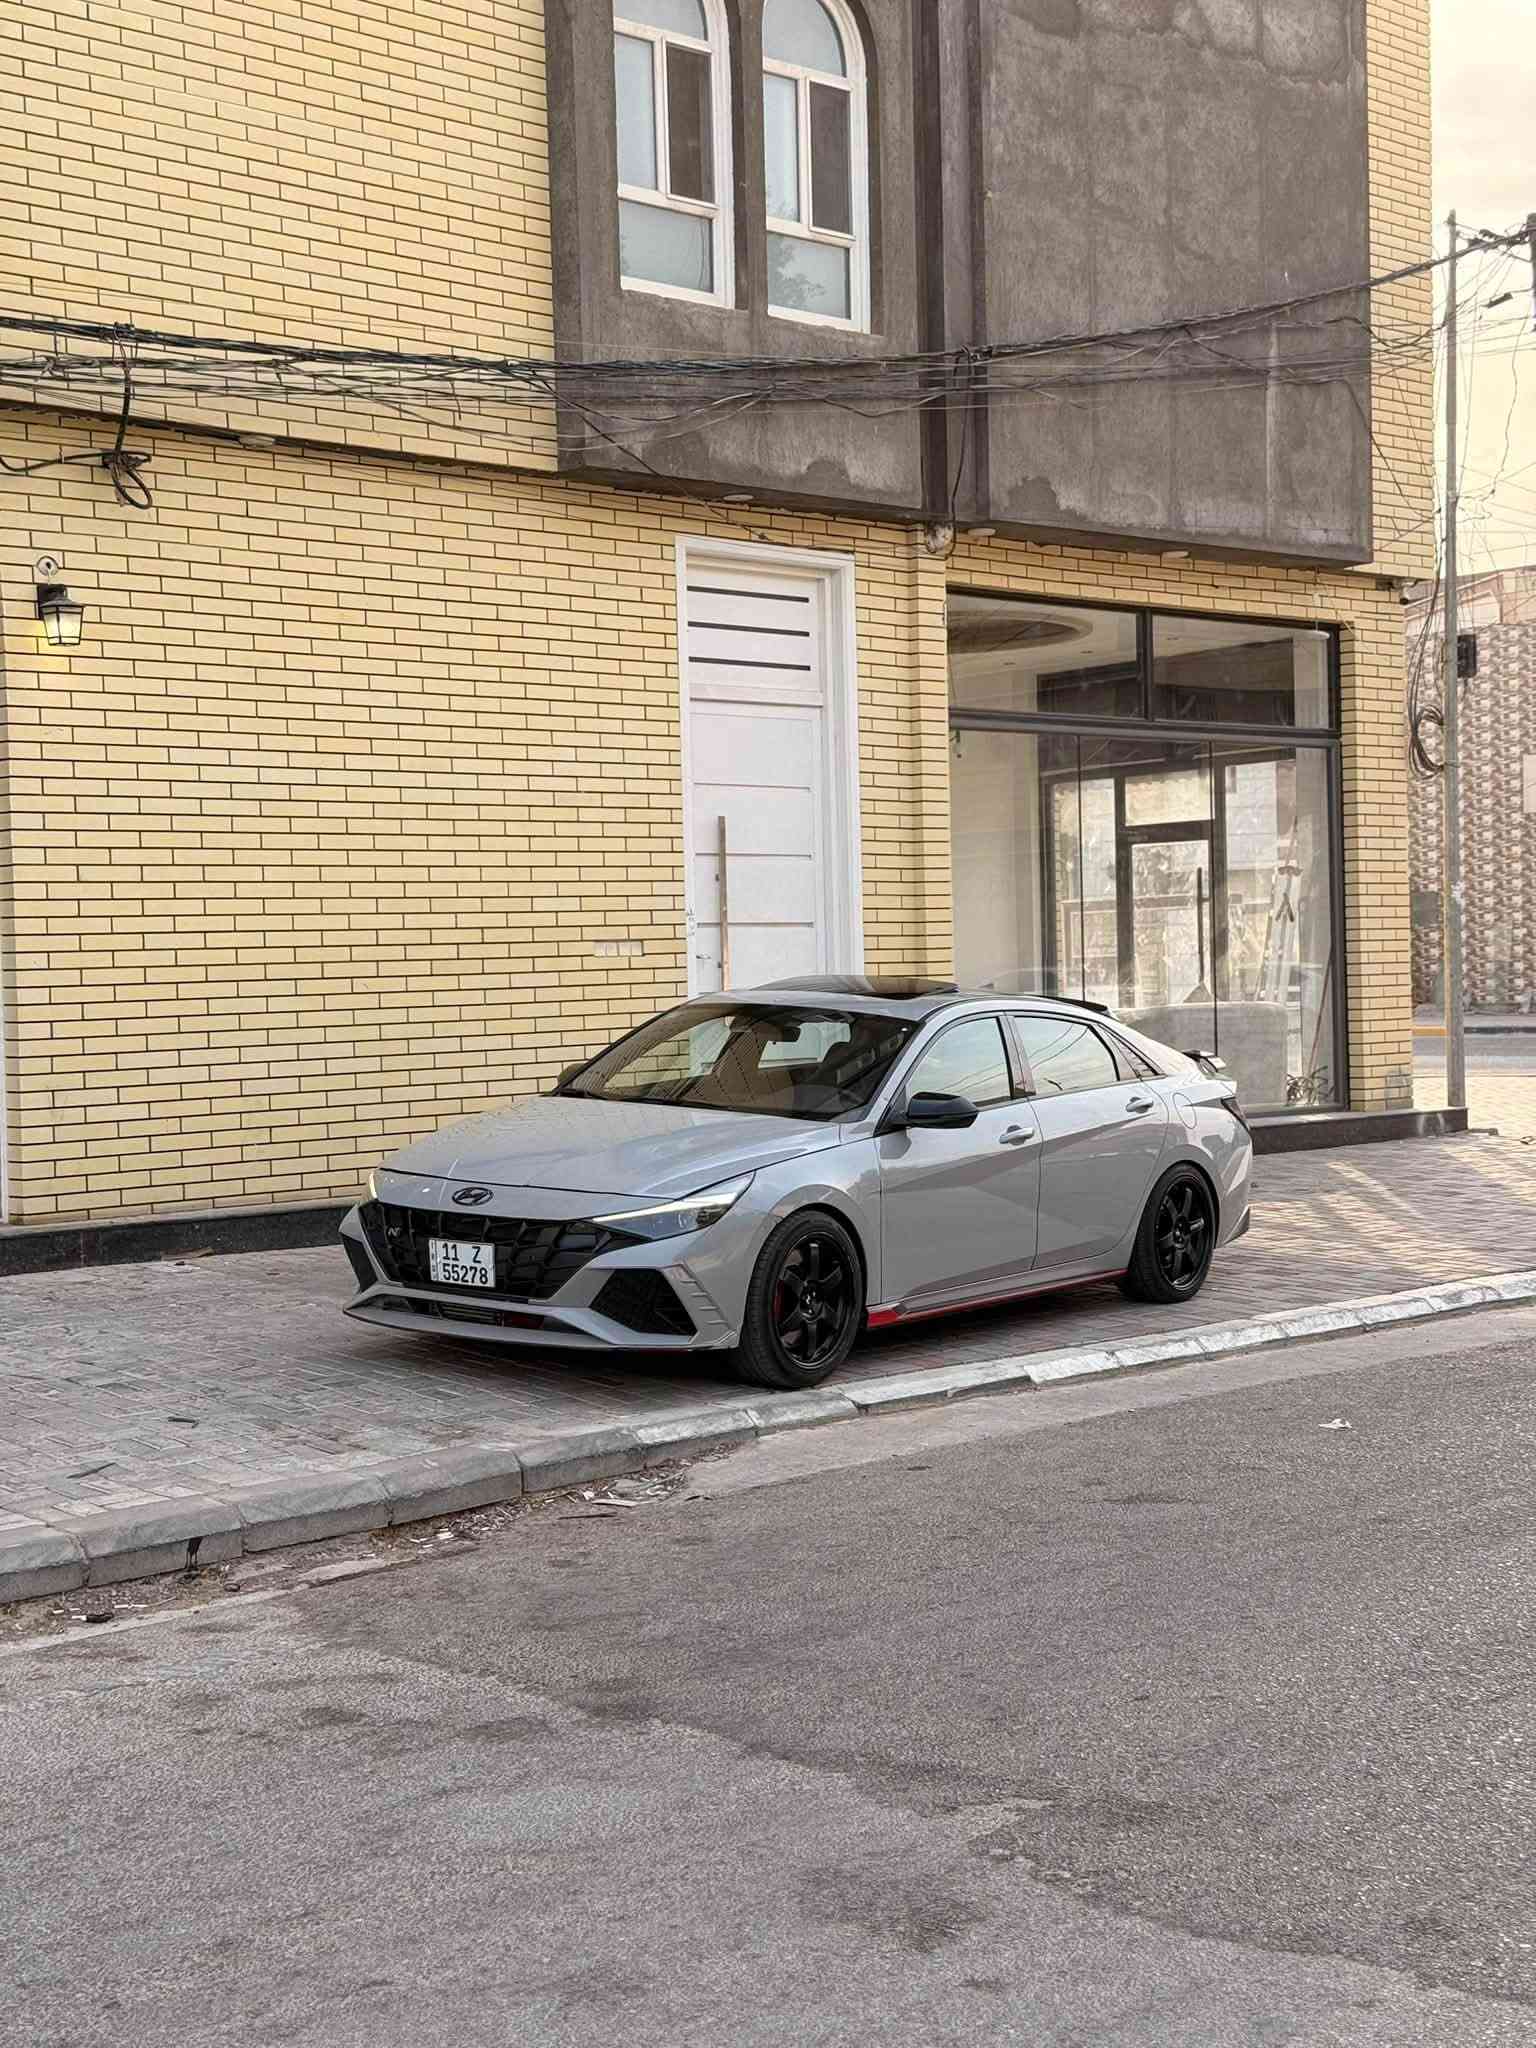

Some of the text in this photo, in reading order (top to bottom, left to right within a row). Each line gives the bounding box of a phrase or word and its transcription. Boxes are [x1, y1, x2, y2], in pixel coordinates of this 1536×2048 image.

[442, 1243, 459, 1261] 11
[472, 1246, 482, 1264] Z
[443, 1263, 488, 1284] 55278
